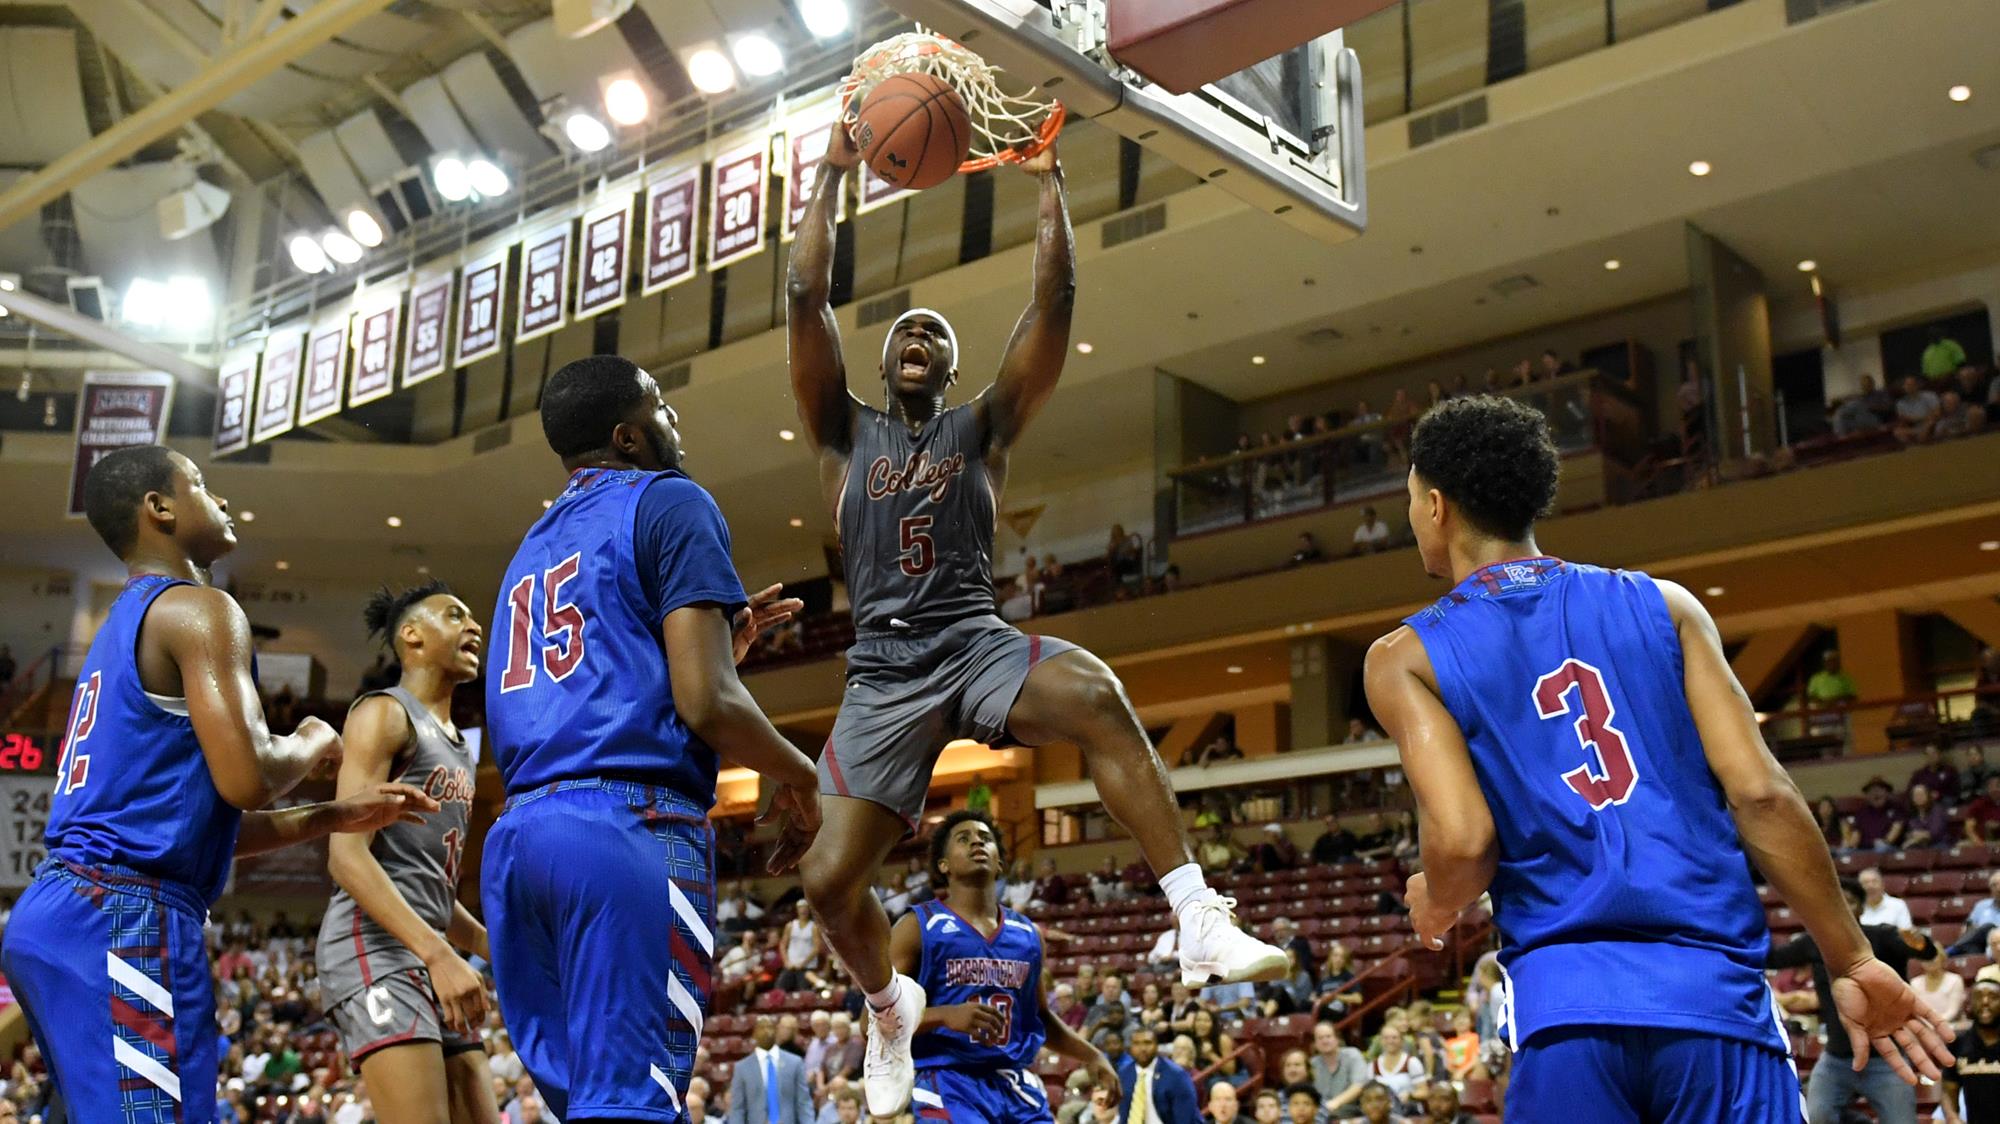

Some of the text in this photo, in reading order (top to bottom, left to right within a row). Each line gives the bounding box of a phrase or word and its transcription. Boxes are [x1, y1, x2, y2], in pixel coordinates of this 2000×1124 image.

[724, 192, 752, 232] 20
[659, 220, 682, 257] 21
[591, 247, 617, 282] 42
[531, 272, 555, 307] 24
[469, 298, 492, 333] 10
[416, 319, 438, 351] 55
[867, 450, 965, 503] College
[899, 515, 936, 577] 5
[500, 551, 585, 694] 15
[0, 733, 43, 770] 26
[1531, 658, 1640, 811] 3
[10, 789, 50, 814] 24
[13, 821, 46, 843] 12
[366, 986, 393, 1025] C
